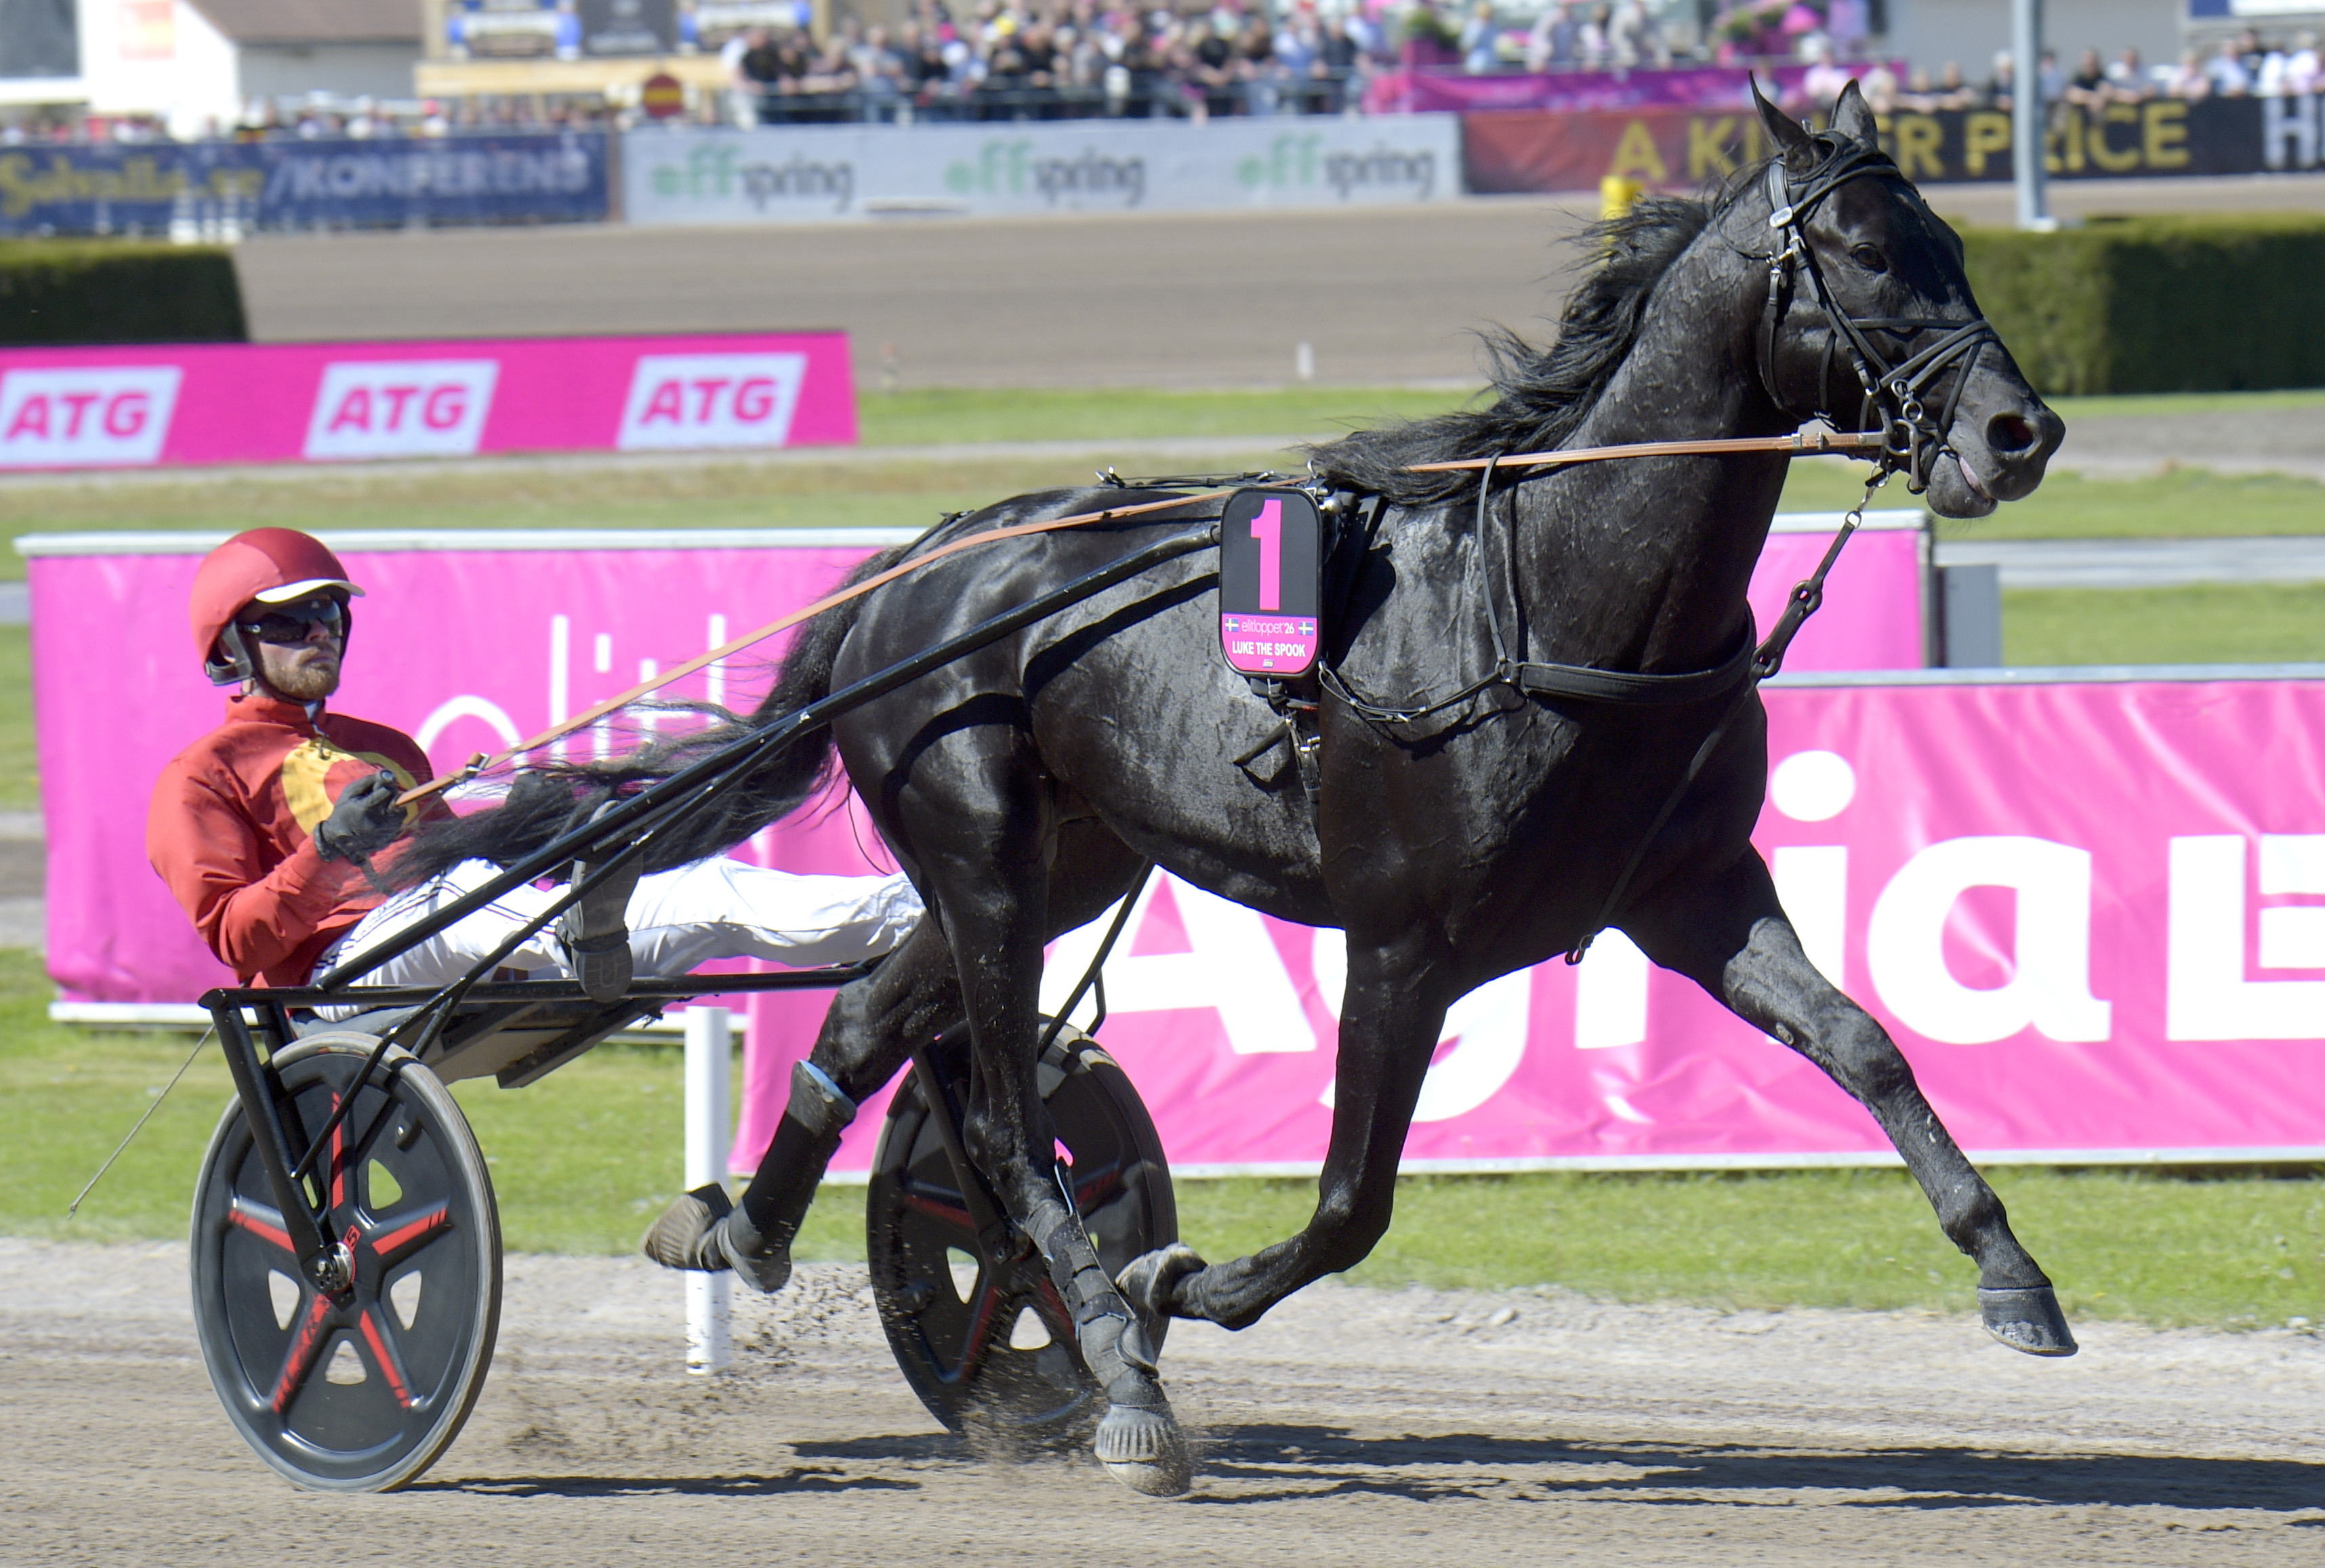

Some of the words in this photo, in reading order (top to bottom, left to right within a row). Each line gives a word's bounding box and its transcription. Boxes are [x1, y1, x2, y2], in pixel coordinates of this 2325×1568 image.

[1611, 118, 1666, 182] A
[1967, 101, 2191, 178] PICE
[5, 391, 150, 442] ATG
[327, 384, 468, 434] ATG
[638, 377, 777, 427] ATG
[1250, 499, 1281, 611] 1
[1232, 640, 1255, 655] LUKE
[1255, 642, 1273, 656] THE
[1275, 642, 1306, 657] SPOOK
